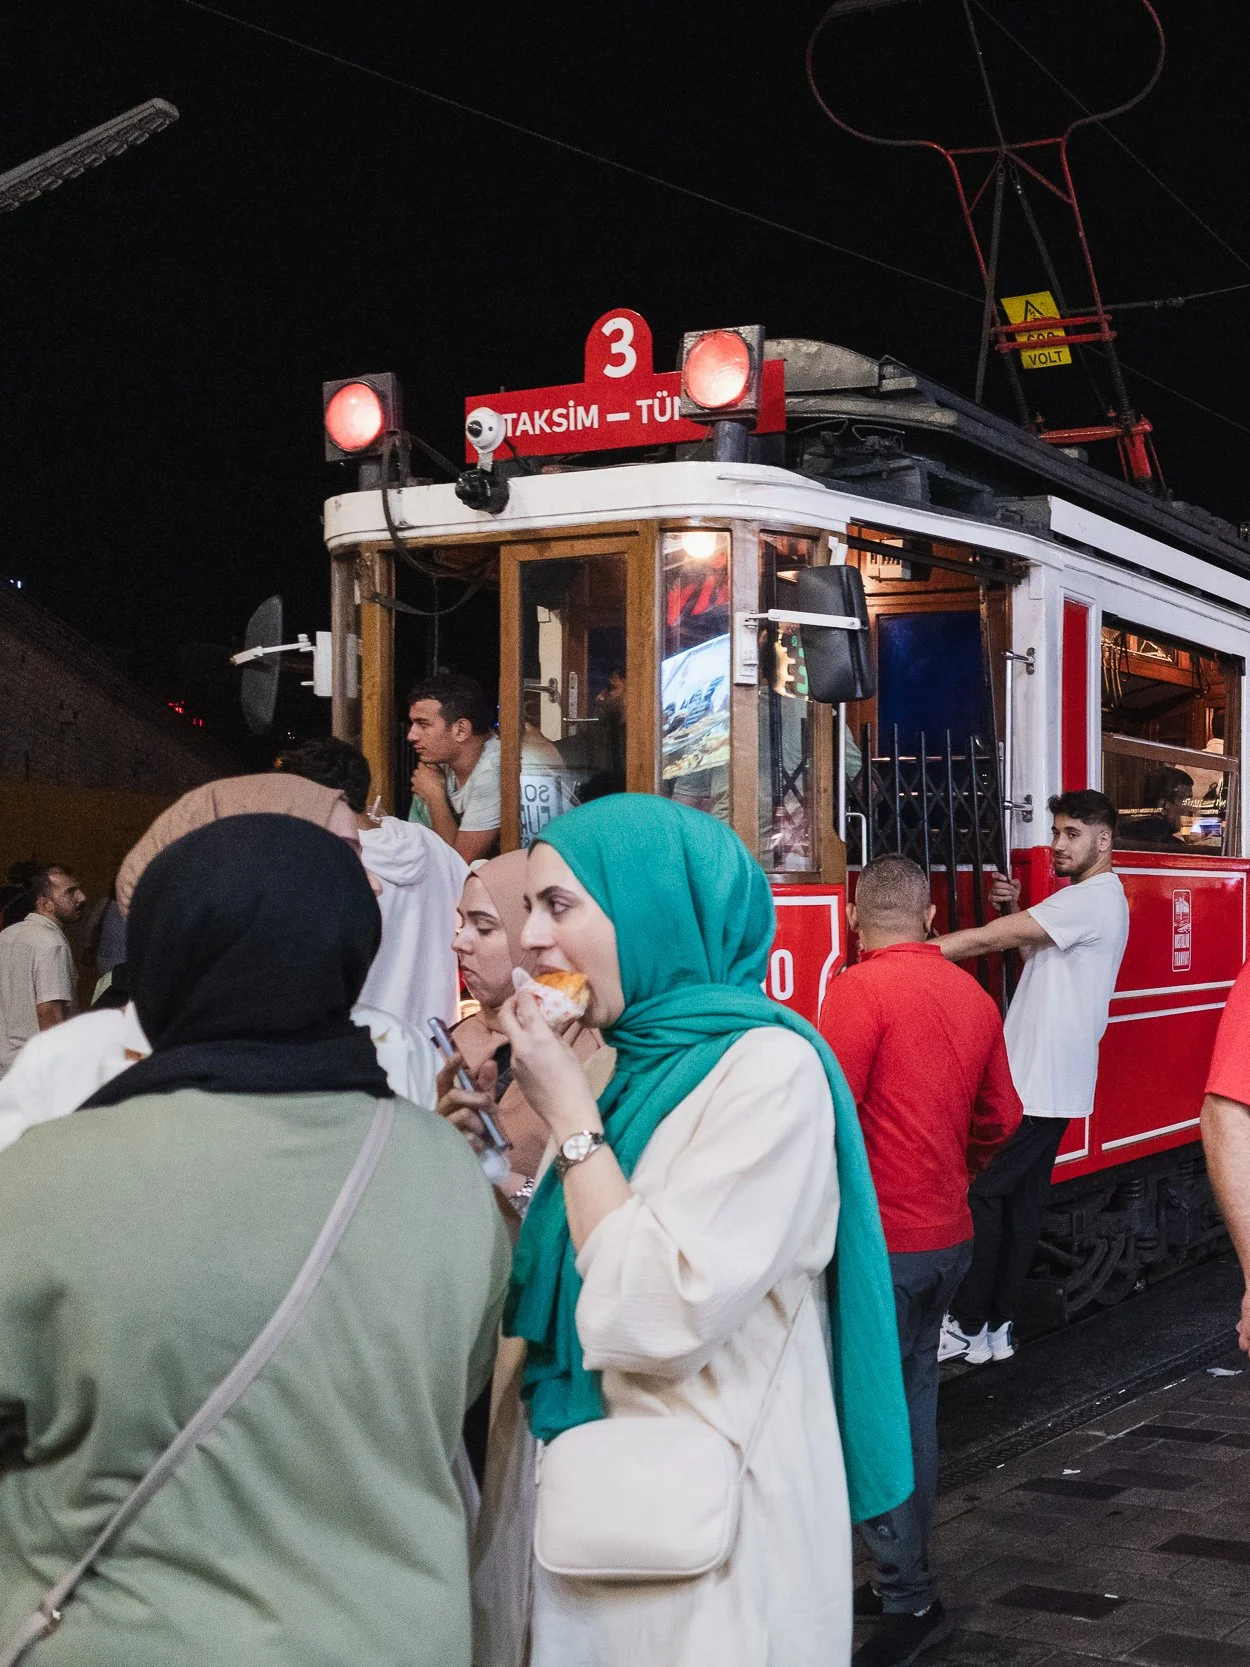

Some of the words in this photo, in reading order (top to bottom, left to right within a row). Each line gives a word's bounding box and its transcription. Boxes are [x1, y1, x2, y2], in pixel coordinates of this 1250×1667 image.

[601, 317, 638, 378] 3
[1028, 350, 1063, 366] VOLT
[502, 400, 599, 437] TAKSİM
